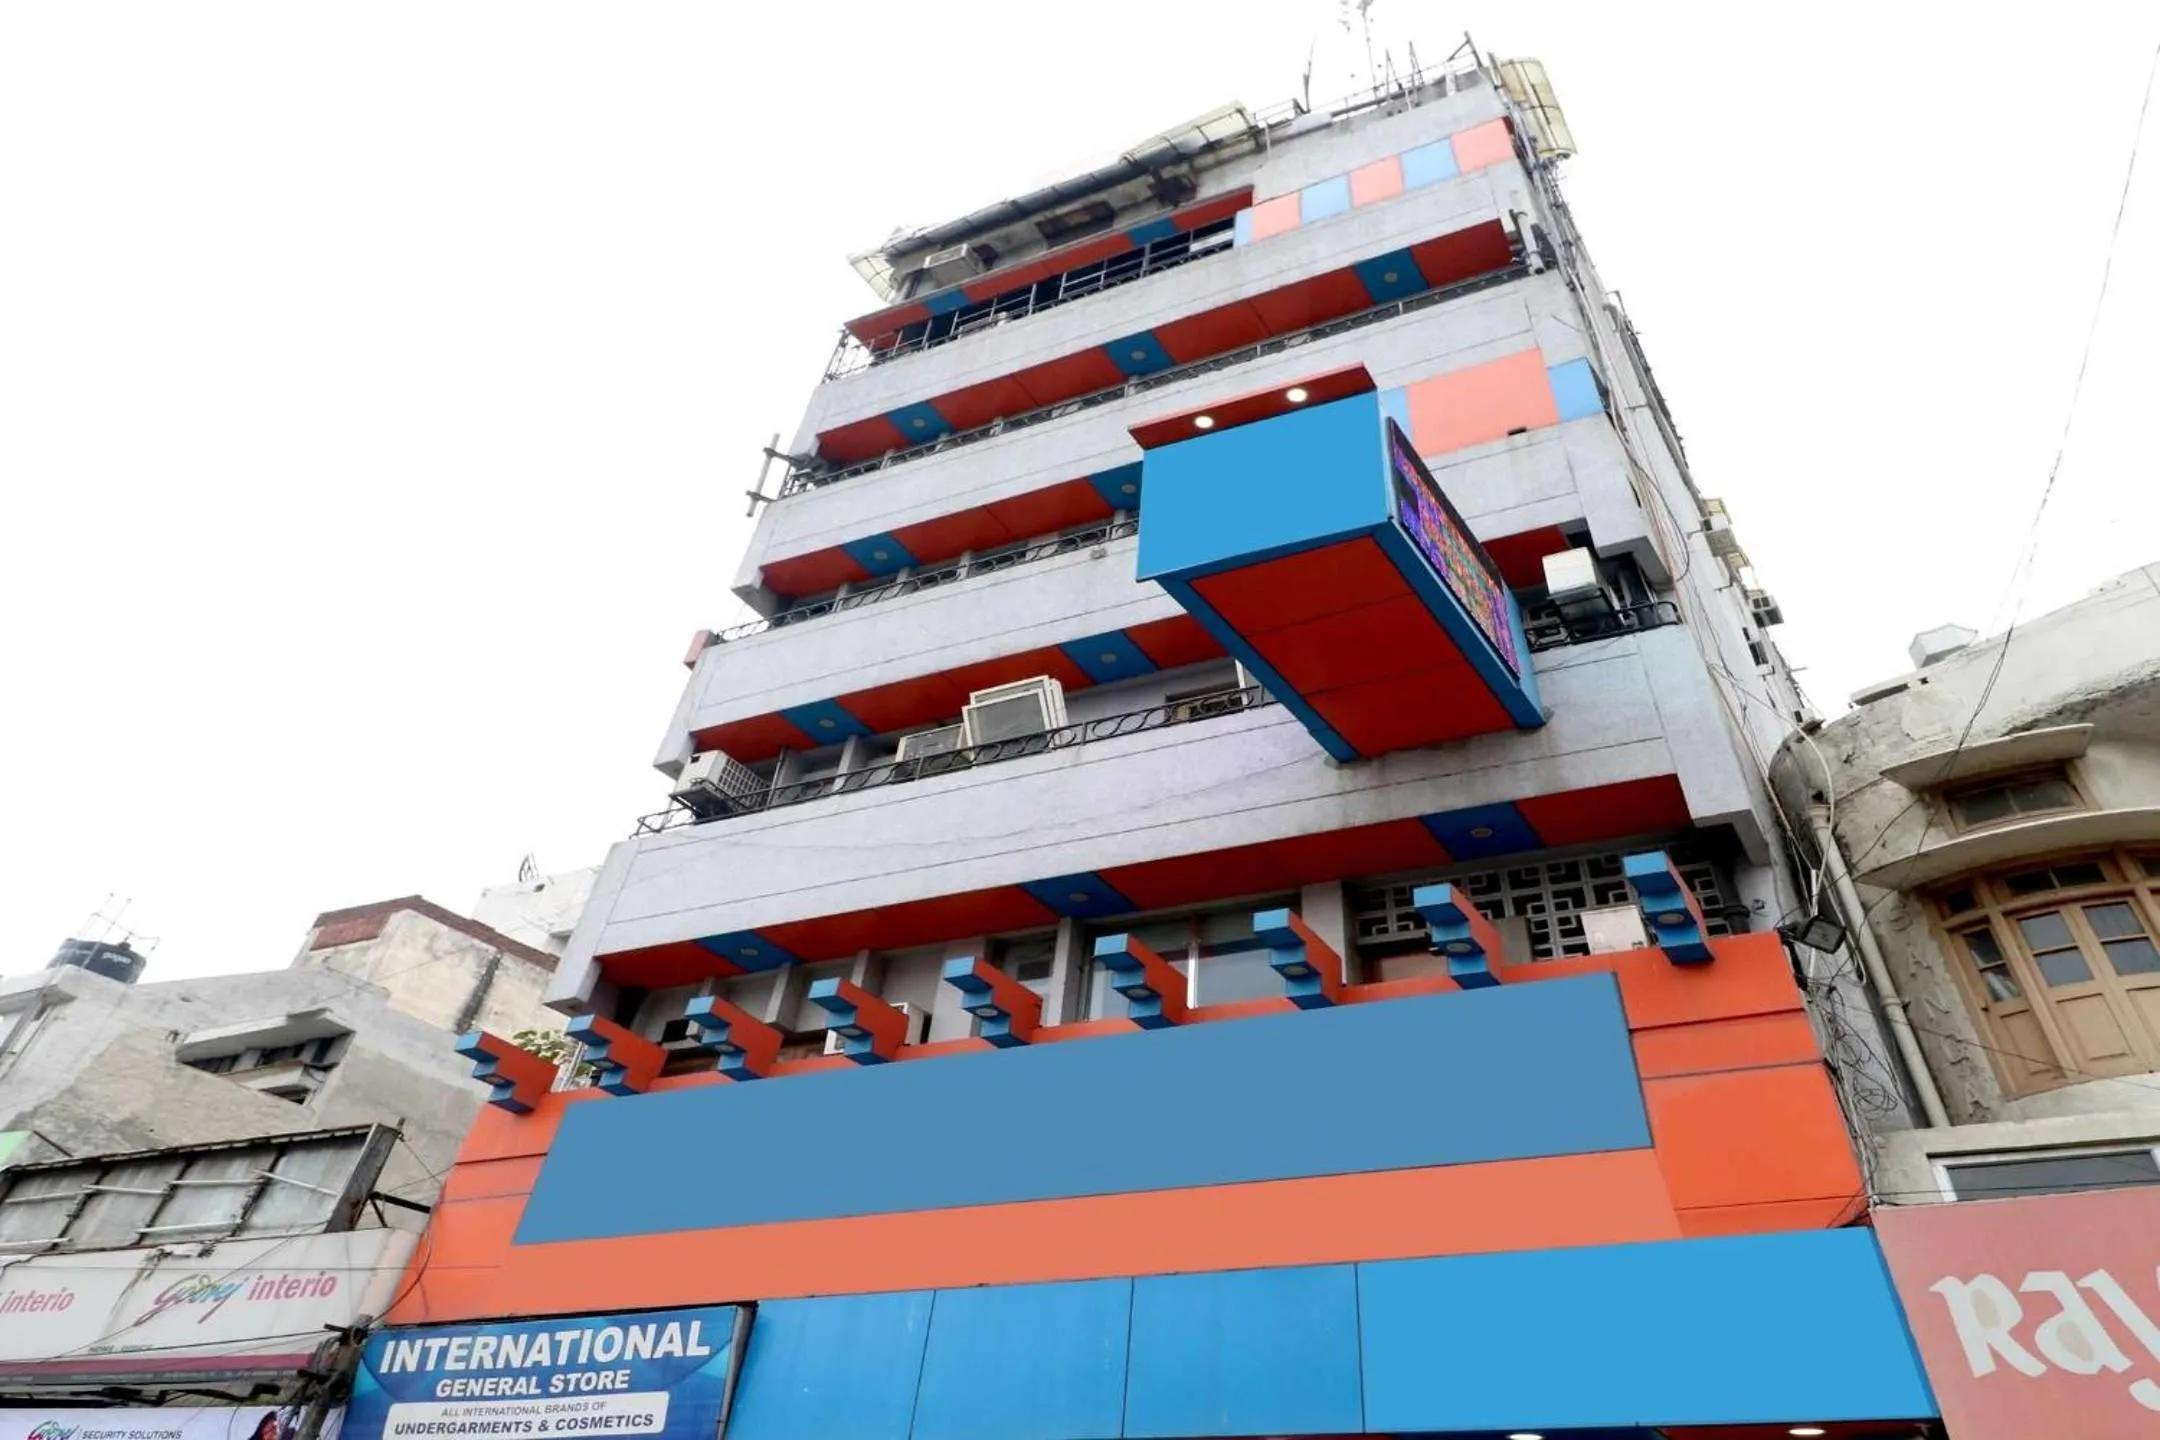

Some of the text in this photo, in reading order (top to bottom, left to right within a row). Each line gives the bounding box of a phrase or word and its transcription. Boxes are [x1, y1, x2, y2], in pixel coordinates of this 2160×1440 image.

[0, 1287, 77, 1313] interio
[133, 1271, 338, 1326] Godrej interio
[379, 1320, 711, 1373] INTERNATIONAL
[436, 1369, 631, 1397] GENERAL STORE
[441, 1401, 608, 1417] ALL INTERNATIONAL BRANDS OF
[81, 1429, 127, 1440] SECURITY
[127, 1429, 183, 1440] SOLUTIONS
[394, 1413, 655, 1436] UNDERGARMENTS & COSMETICS
